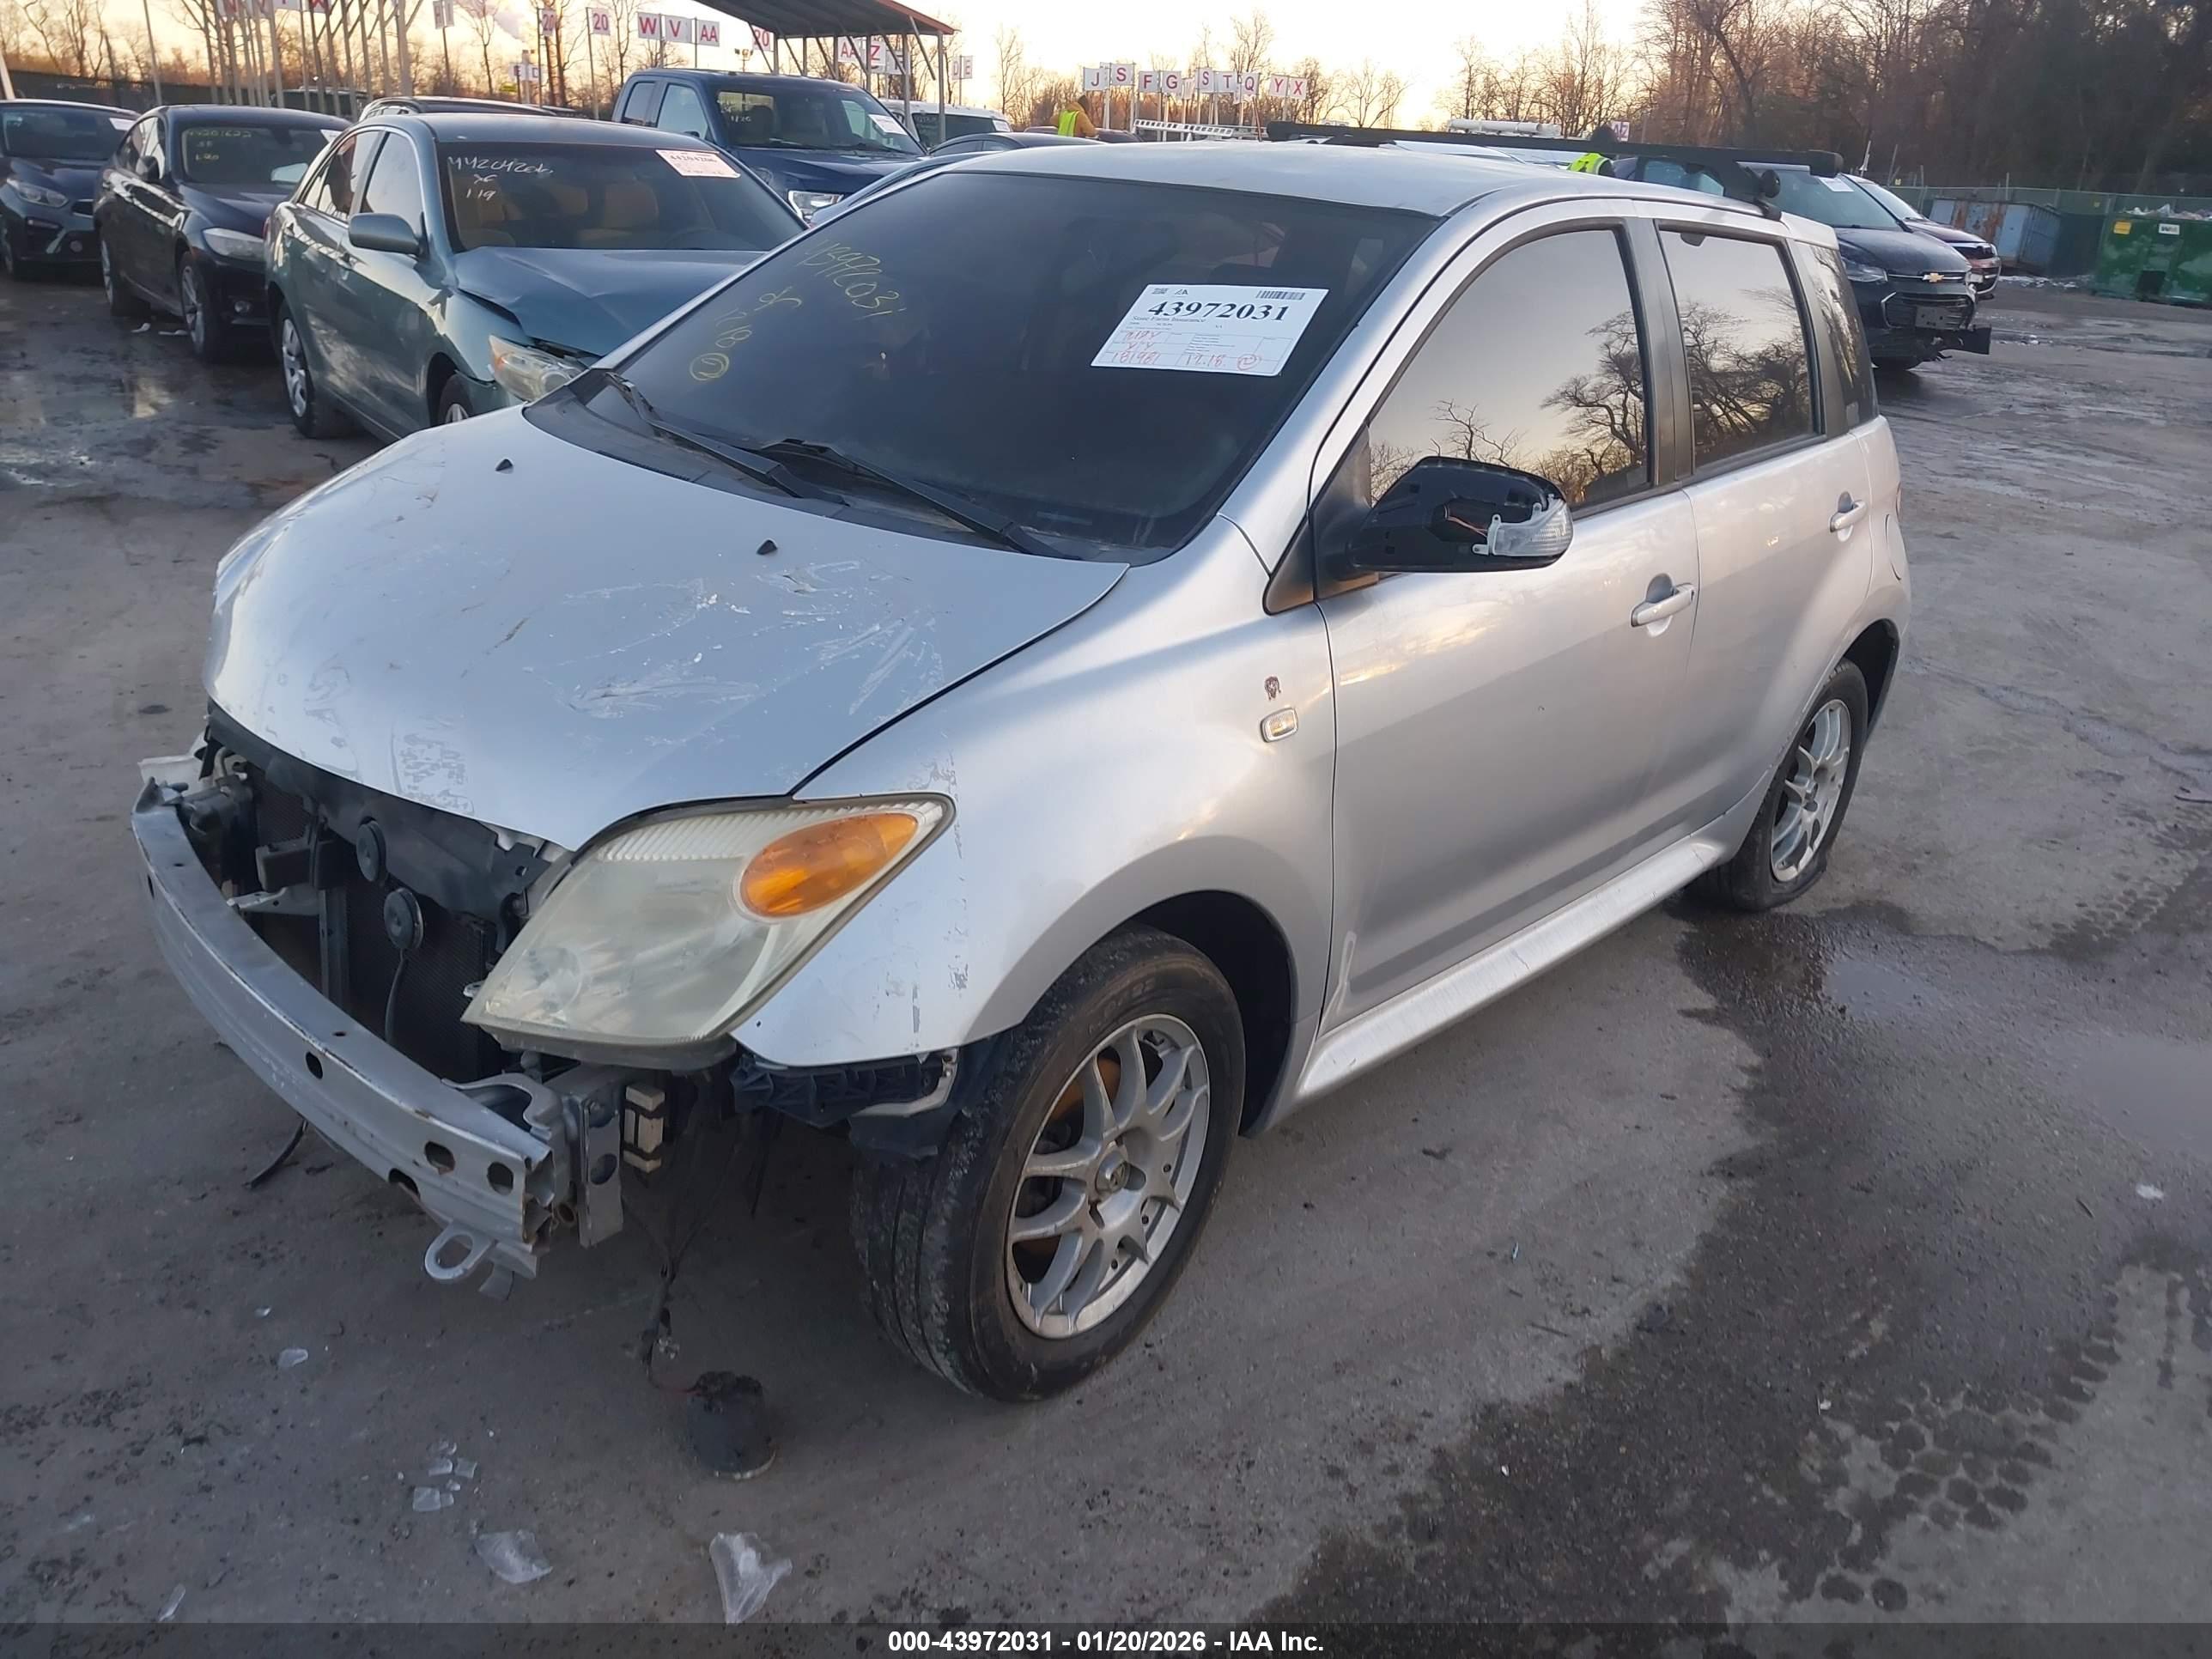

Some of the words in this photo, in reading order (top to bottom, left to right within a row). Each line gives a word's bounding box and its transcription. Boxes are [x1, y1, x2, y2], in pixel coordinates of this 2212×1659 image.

[593, 13, 609, 31] 20
[639, 16, 657, 35] W
[669, 20, 681, 37] V
[700, 24, 718, 42] AA
[870, 45, 880, 61] Z
[1091, 71, 1100, 87] J
[1115, 67, 1127, 82] S
[1143, 75, 1152, 88] F
[1165, 74, 1178, 89] G
[1202, 71, 1210, 86] S
[1223, 75, 1232, 88] T
[1244, 76, 1255, 91] Q
[1274, 78, 1284, 93] Y
[1293, 80, 1304, 95] X
[1148, 301, 1290, 321] 43972031
